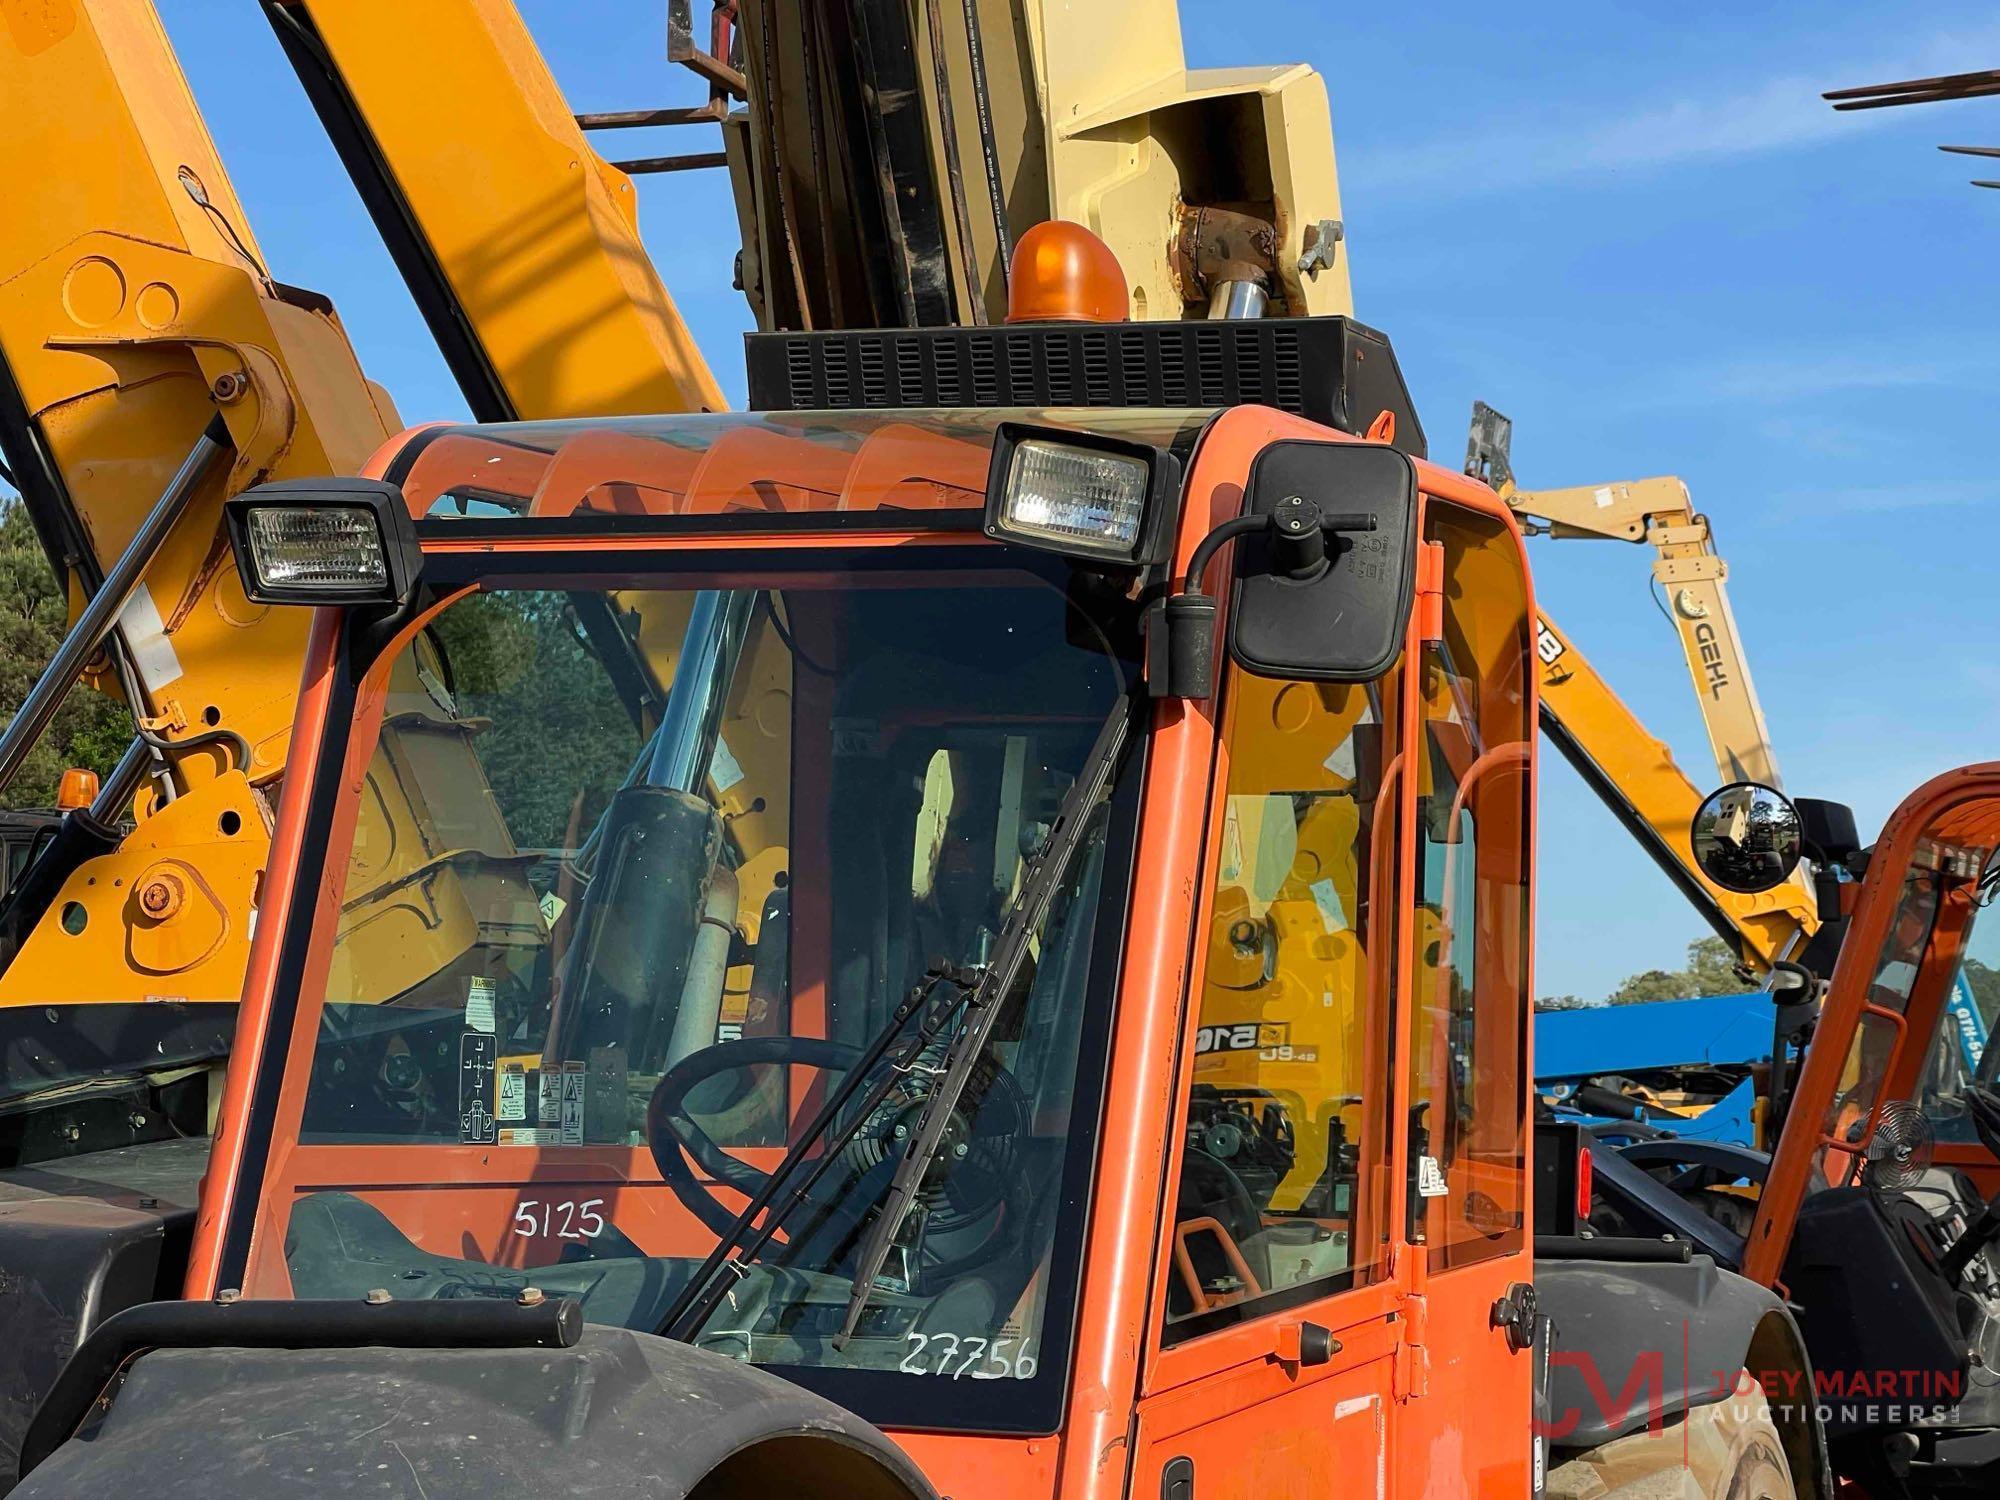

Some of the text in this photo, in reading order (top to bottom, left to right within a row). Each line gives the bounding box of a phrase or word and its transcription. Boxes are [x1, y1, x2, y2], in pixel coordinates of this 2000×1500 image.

[1696, 623, 1728, 701] GEHL
[514, 1199, 604, 1238] 5125
[899, 1332, 1037, 1381] 27756
